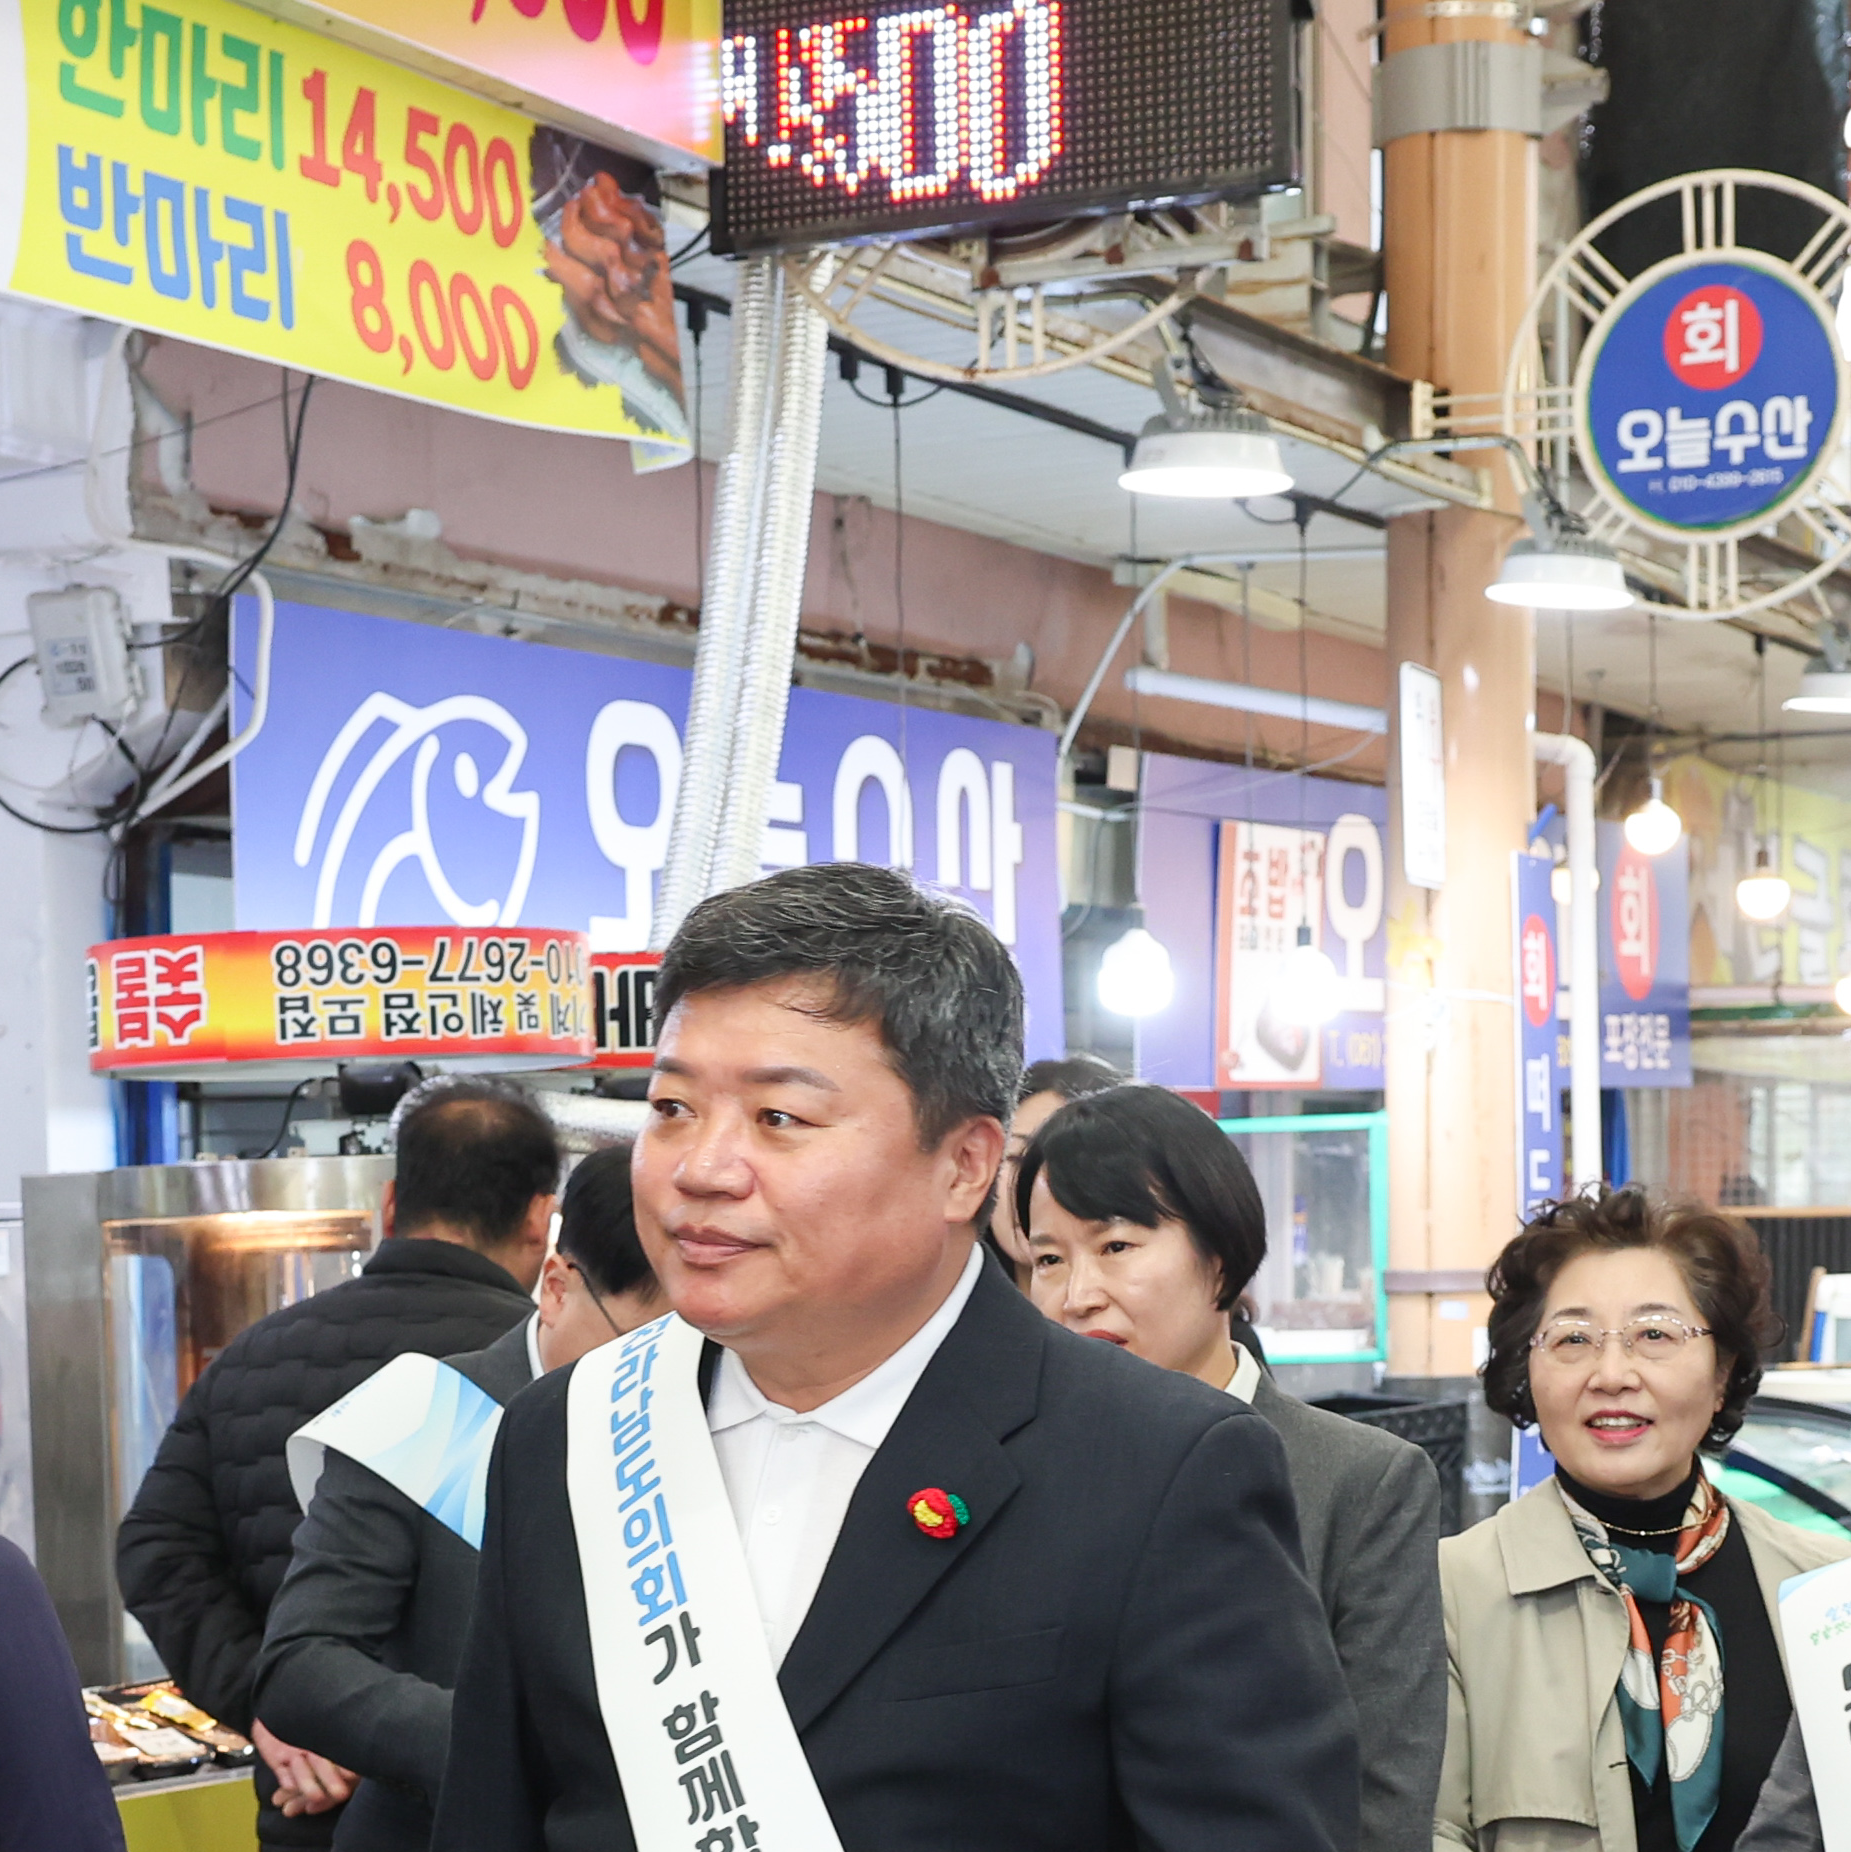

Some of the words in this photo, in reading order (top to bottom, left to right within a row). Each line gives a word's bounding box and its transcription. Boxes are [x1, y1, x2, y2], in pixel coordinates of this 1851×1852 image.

[57, 0, 285, 171] 한마리
[299, 68, 524, 249] 14,500
[56, 143, 295, 330] 반마리
[346, 238, 539, 391] 8,000
[1680, 298, 1741, 374] 회
[1616, 395, 1814, 474] 오늘수산
[112, 944, 205, 1046] 숯불
[272, 939, 586, 989] 010-2677-6368
[276, 990, 366, 1045] 모집
[382, 991, 505, 1043] 체인점
[516, 992, 542, 1035] 및
